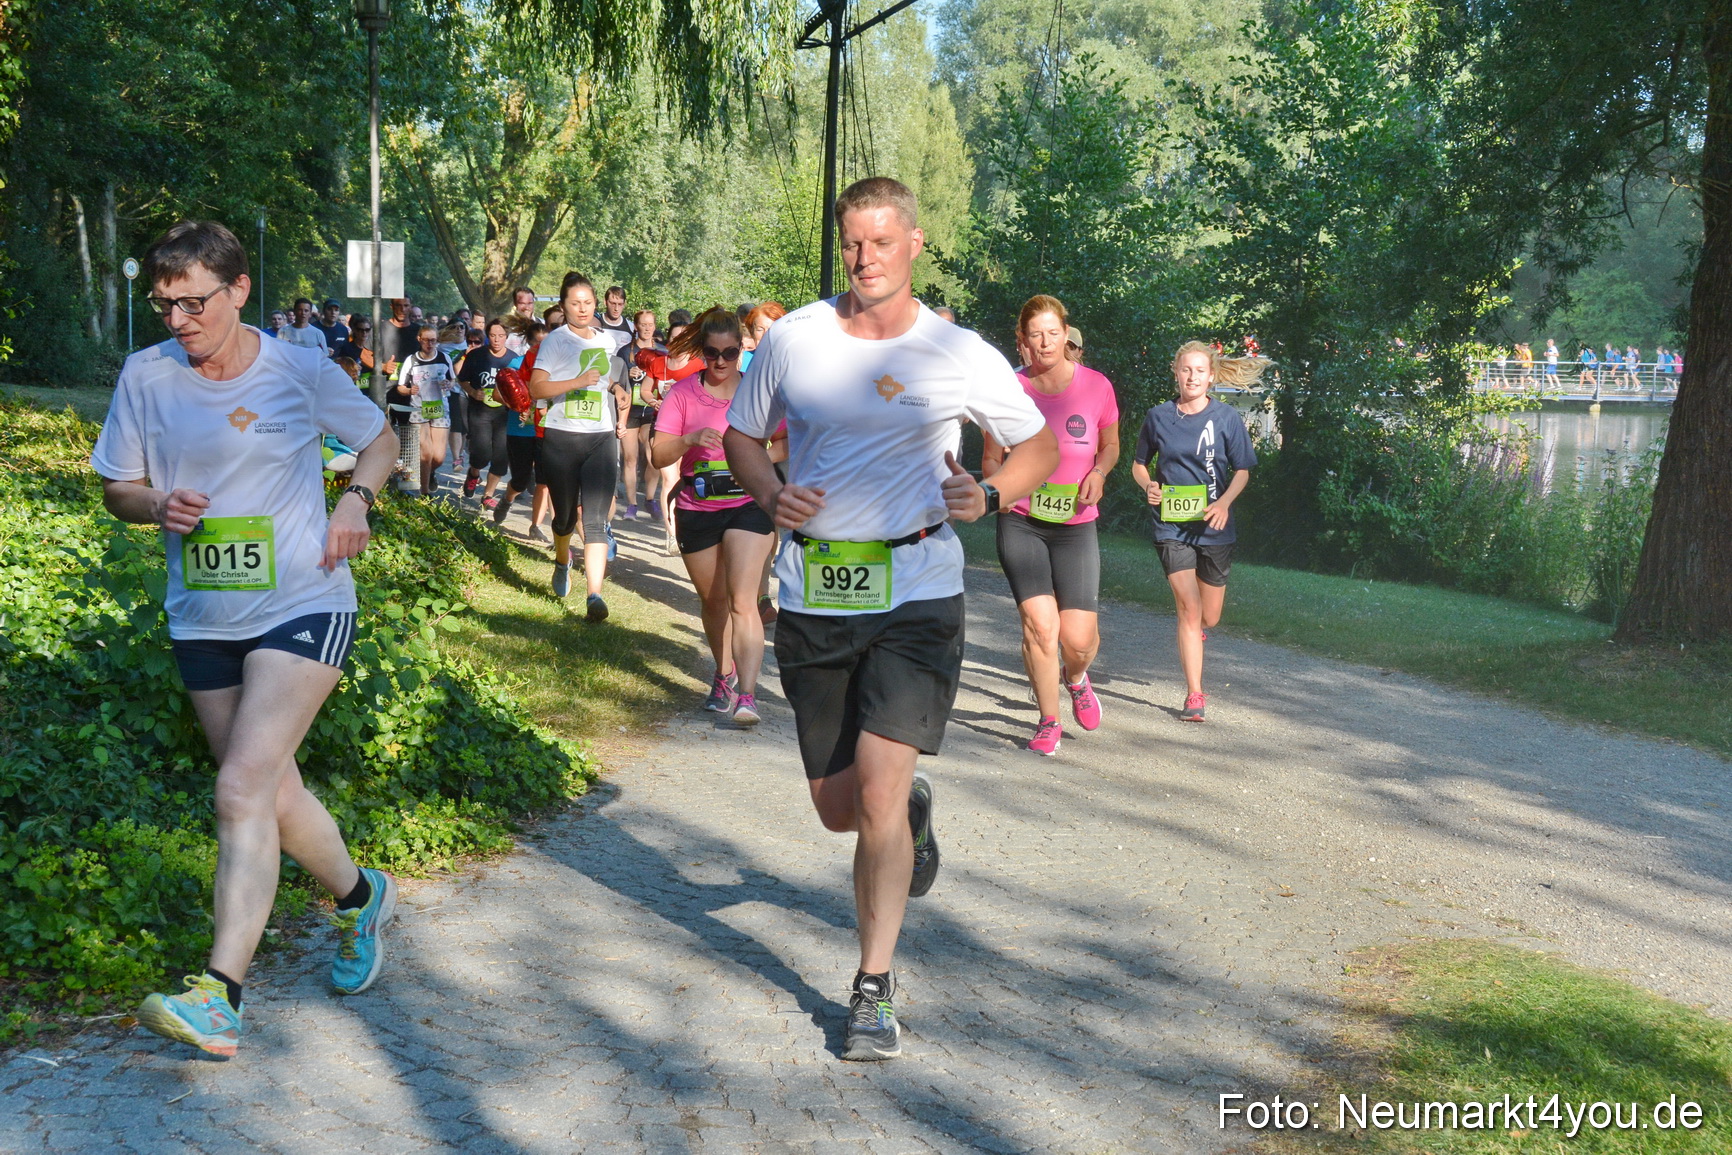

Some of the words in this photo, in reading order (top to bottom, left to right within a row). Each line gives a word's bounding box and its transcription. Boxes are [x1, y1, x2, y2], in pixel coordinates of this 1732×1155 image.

[899, 400, 930, 408] NEUMARKT
[900, 394, 930, 402] LANDKREIS
[574, 399, 595, 412] 137
[1205, 448, 1218, 500] AIL.ONE
[1035, 493, 1072, 512] 1445
[1166, 498, 1200, 511] 1607
[190, 543, 262, 570] 1015
[201, 570, 219, 578] Übler
[821, 565, 870, 591] 992
[814, 590, 853, 599] Ehrnsberger
